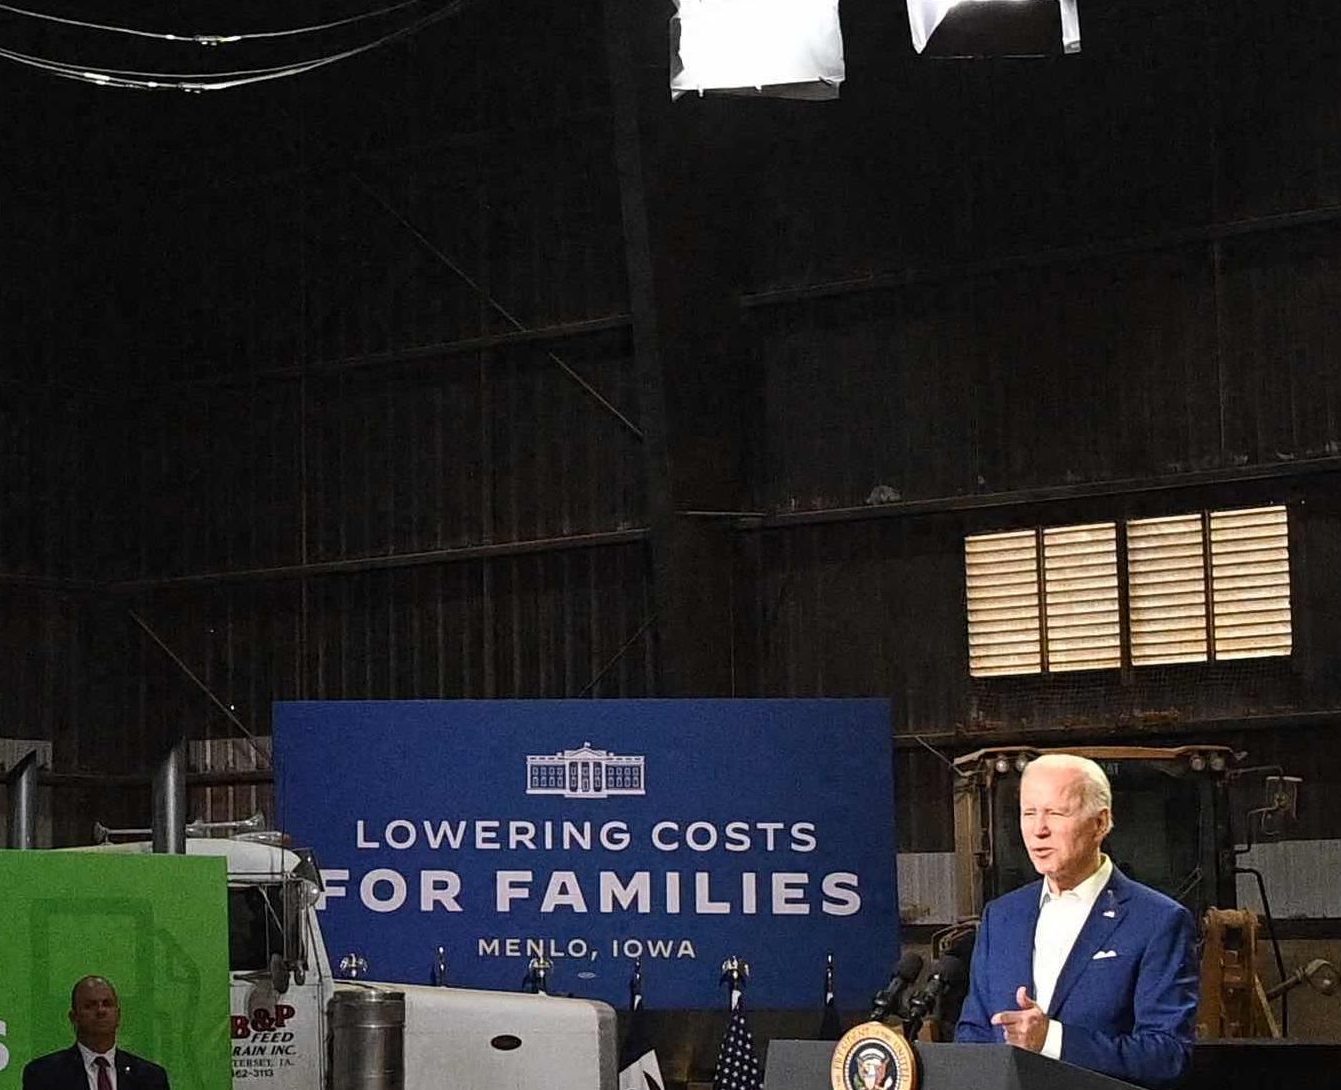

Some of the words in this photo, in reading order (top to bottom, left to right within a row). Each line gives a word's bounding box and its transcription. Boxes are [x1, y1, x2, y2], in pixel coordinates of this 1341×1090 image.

[356, 819, 631, 851] LOWERING
[651, 821, 818, 852] COSTS
[315, 868, 463, 913] FOR
[495, 870, 862, 917] FAMILIES
[478, 938, 598, 961] MENLO,
[612, 939, 696, 959] IOWA
[230, 1004, 296, 1040] B&P
[251, 1032, 294, 1043] FEED
[232, 1045, 267, 1056] RAIN
[271, 1045, 296, 1055] INC.
[232, 1069, 274, 1078] 62-3113
